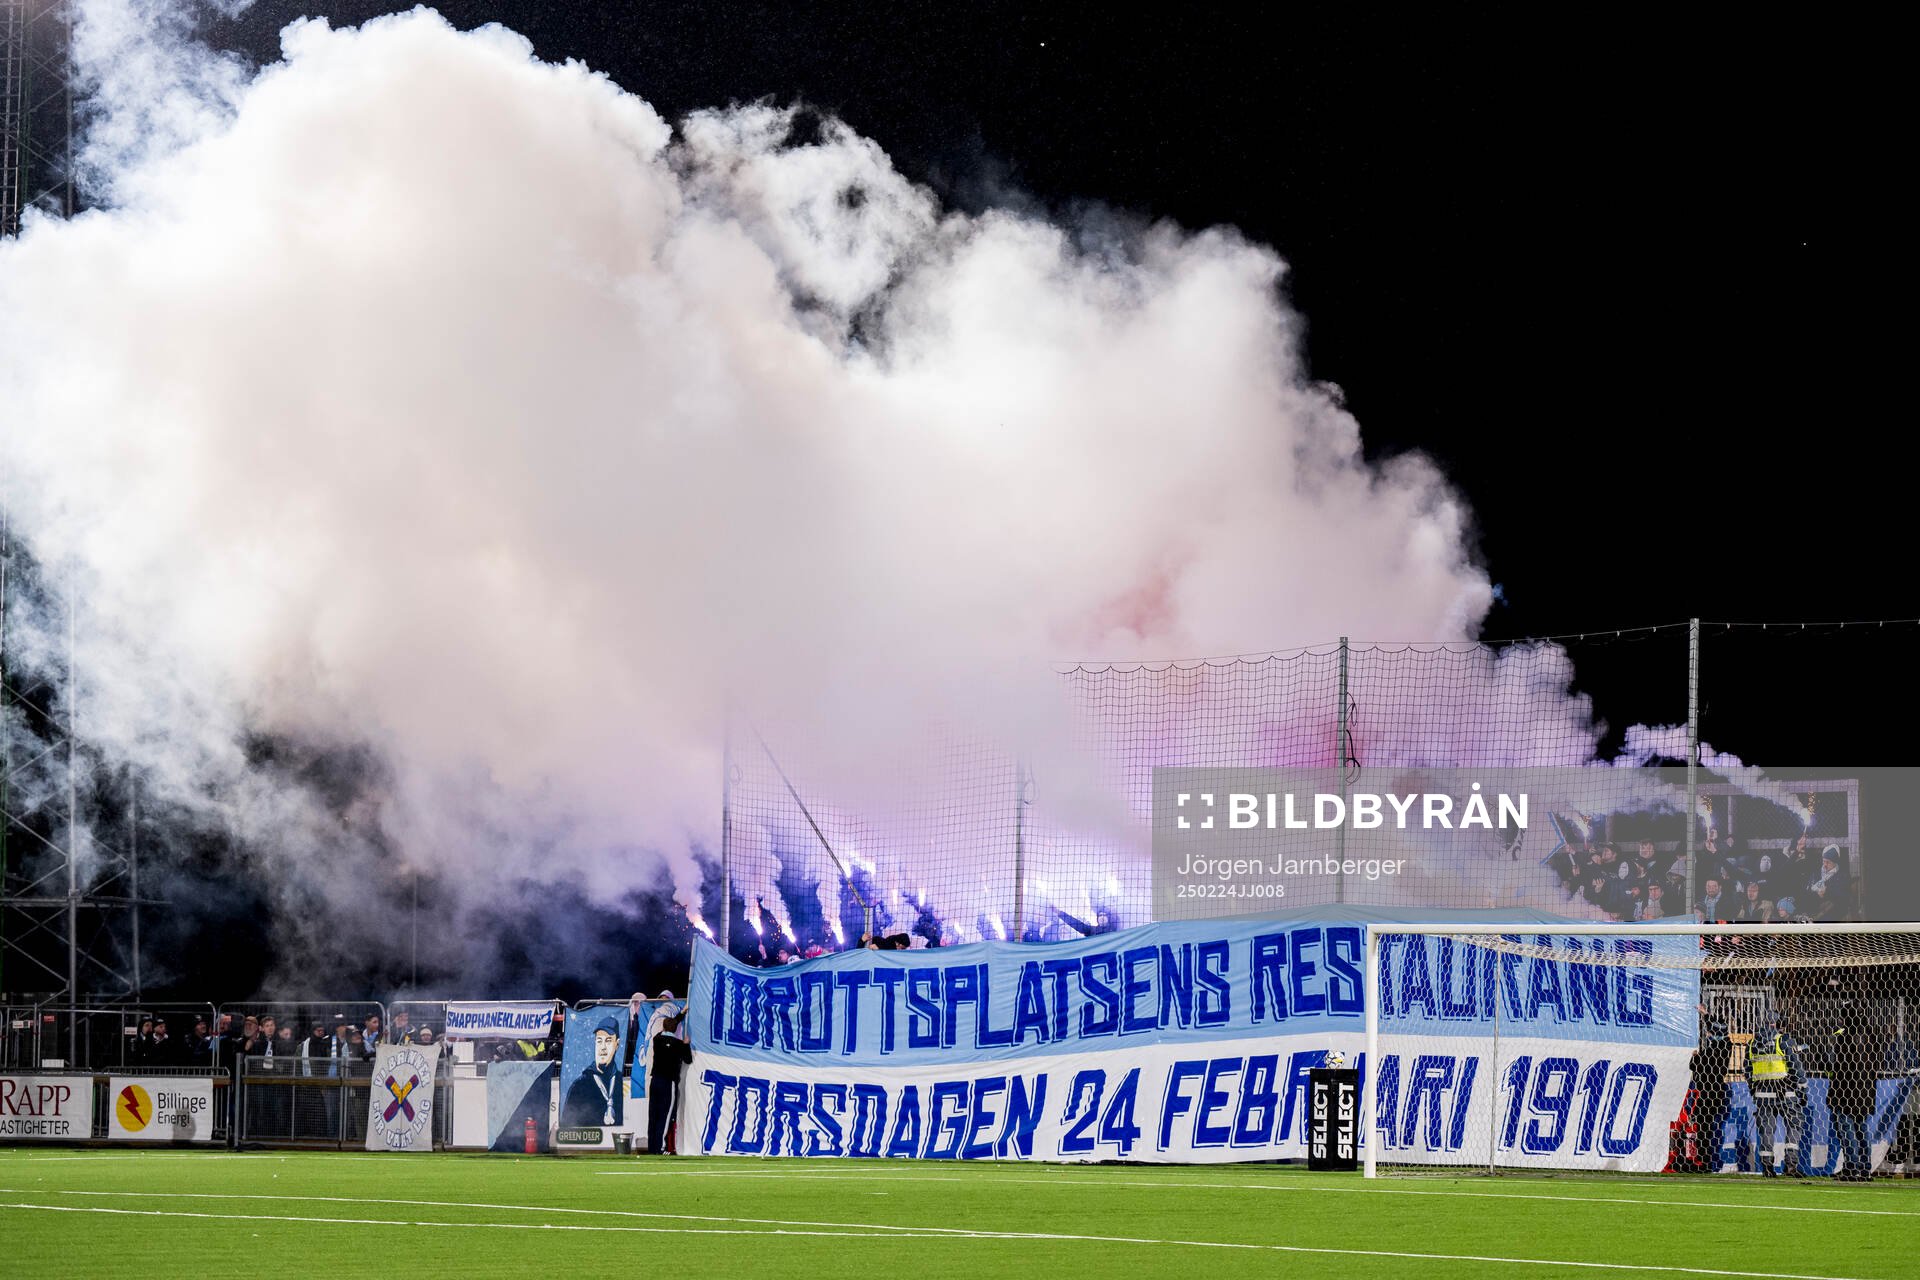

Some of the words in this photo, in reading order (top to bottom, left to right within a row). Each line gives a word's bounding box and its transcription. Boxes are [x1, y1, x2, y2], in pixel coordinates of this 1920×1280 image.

[709, 939, 1230, 1056] IDROTTSPLATSENS
[1250, 926, 1655, 1028] RESTAURANG
[446, 1010, 543, 1030] SNAPPHANEKLANEN
[0, 1079, 71, 1117] RAPP
[157, 1092, 207, 1113] Billinge
[700, 1068, 1049, 1160] TORSDAGEN
[1057, 1066, 1141, 1157] 24
[1499, 1056, 1659, 1157] 1910
[0, 1119, 70, 1135] ASTIGHETER
[157, 1111, 190, 1127] Energi
[1312, 1081, 1329, 1159] SELECT
[1337, 1082, 1354, 1160] SELECT
[558, 1130, 581, 1141] GREEN
[582, 1130, 601, 1141] DEER
